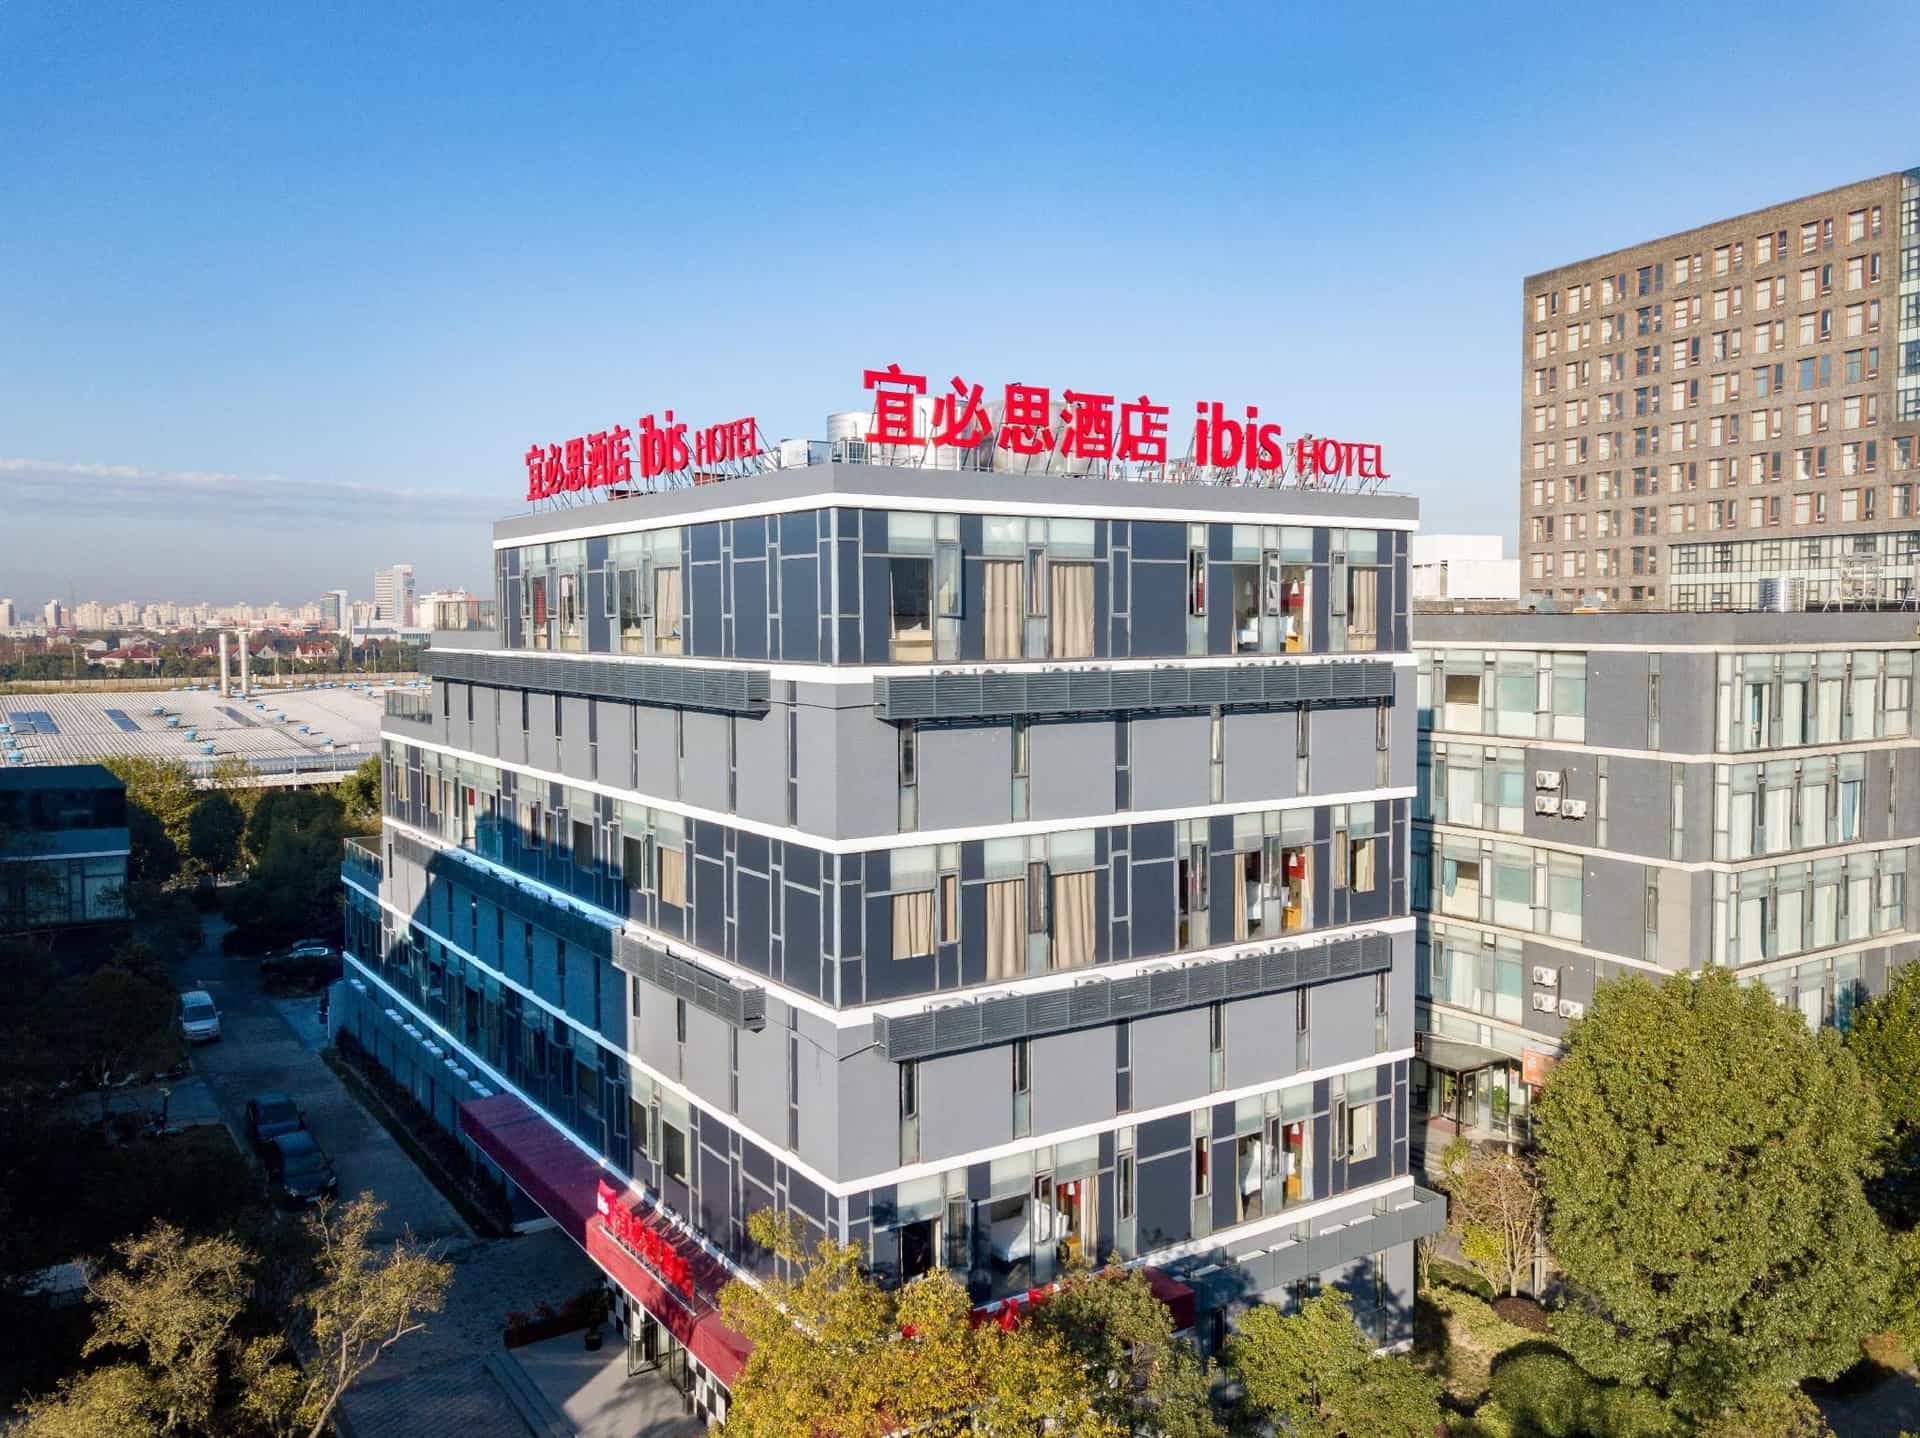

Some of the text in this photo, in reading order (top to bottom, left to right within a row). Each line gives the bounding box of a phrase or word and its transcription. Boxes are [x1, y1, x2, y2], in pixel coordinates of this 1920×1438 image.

[525, 410, 763, 501] 宜必思酒店 ibis HOTEL
[864, 363, 1390, 479] 宜必思酒店 ibis HOTEL
